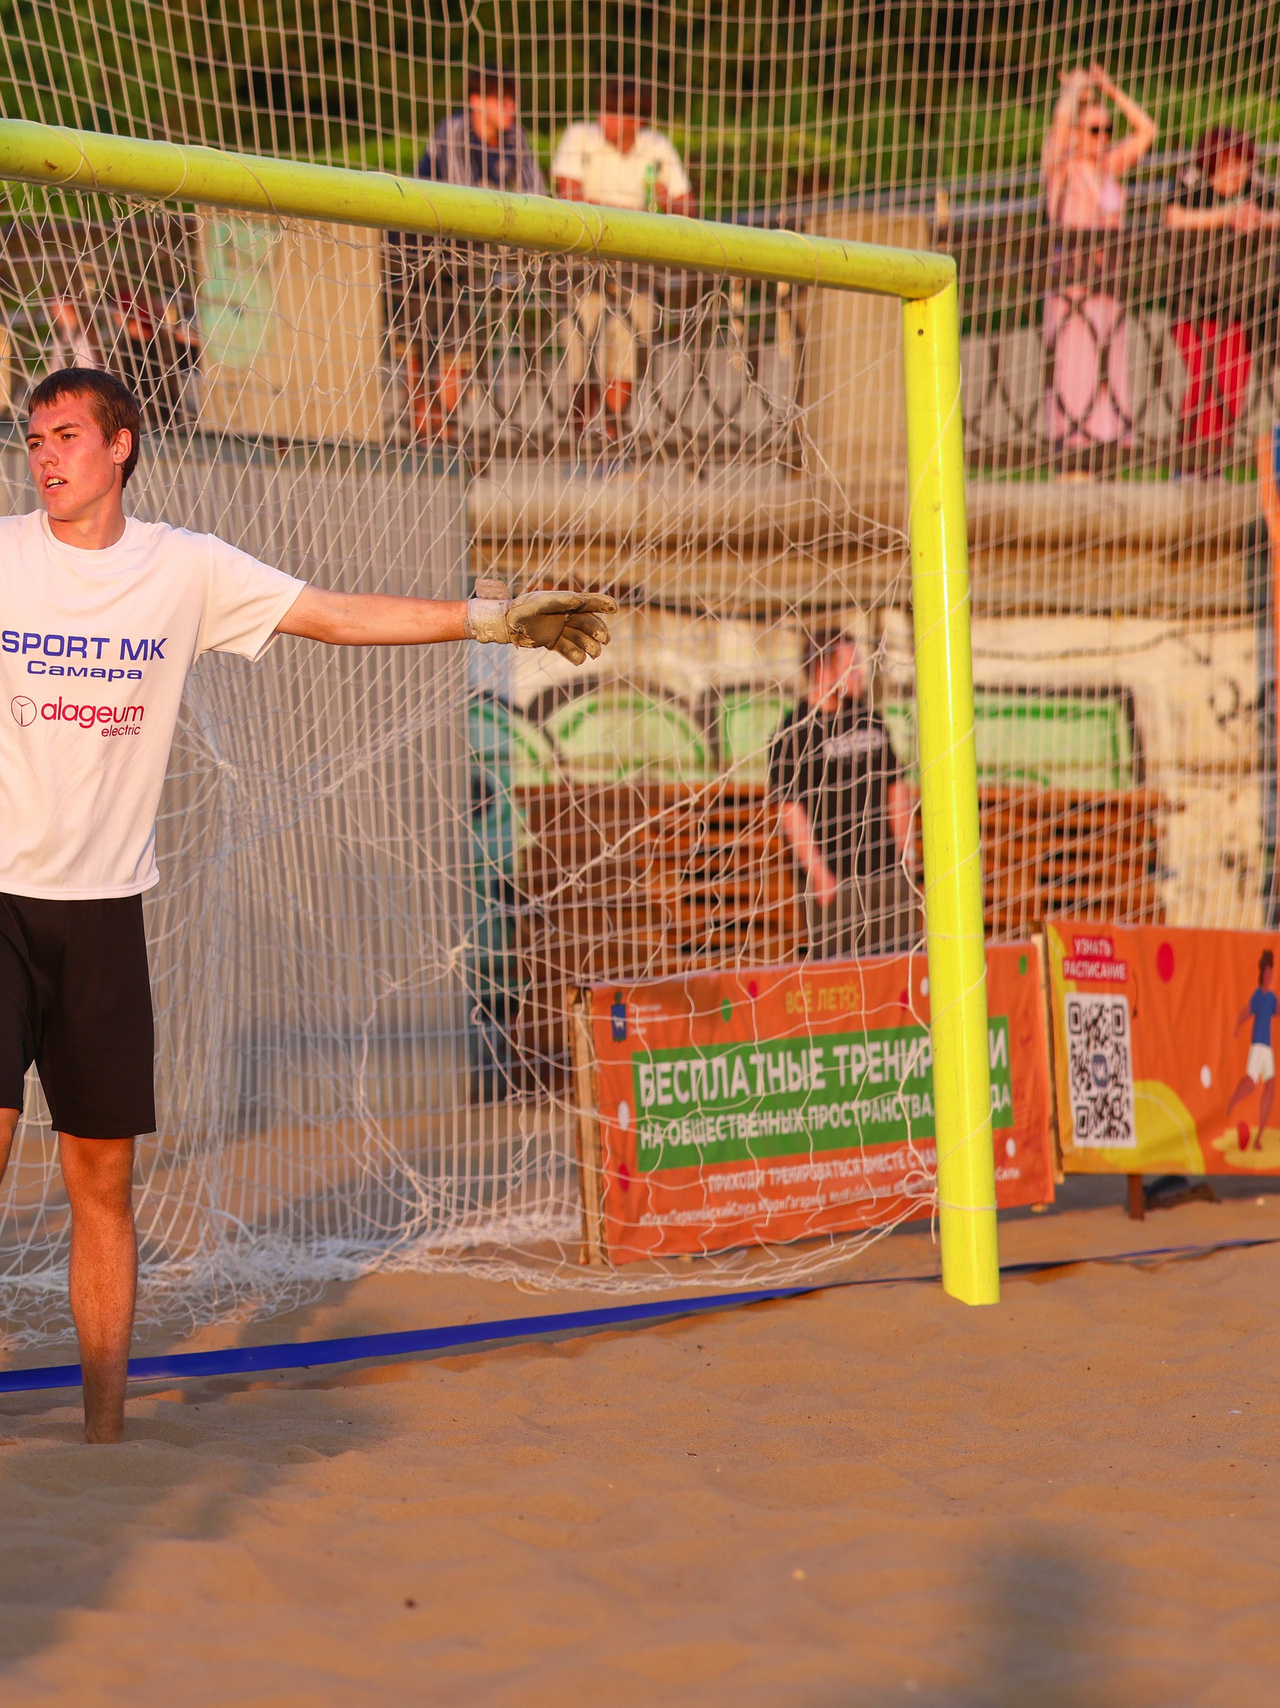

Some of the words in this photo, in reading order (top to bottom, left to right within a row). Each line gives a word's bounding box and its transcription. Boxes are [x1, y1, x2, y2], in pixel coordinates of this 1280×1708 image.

[2, 630, 110, 659] SPORT
[120, 638, 168, 661] MK
[27, 660, 143, 682] Самара
[41, 696, 144, 728] alageum
[101, 724, 141, 737] electric
[1074, 938, 1112, 957] УЗНАТЬ
[1063, 959, 1126, 981] РАСПИСАНИЕ
[786, 982, 813, 1015] ВСЁ
[639, 1047, 827, 1107] БЕСПЛАТНЫЕ
[833, 1027, 1008, 1087] ТРЕНИРИ
[640, 1122, 665, 1150] НА
[668, 1107, 804, 1148] ОБЩЕСТВЕННЫХ
[808, 1092, 936, 1131] ПРОСТРАНСТВА
[708, 1169, 766, 1193] ПРИХОДИ
[770, 1159, 862, 1186] ТРЕНИРОВАТЬСЯ
